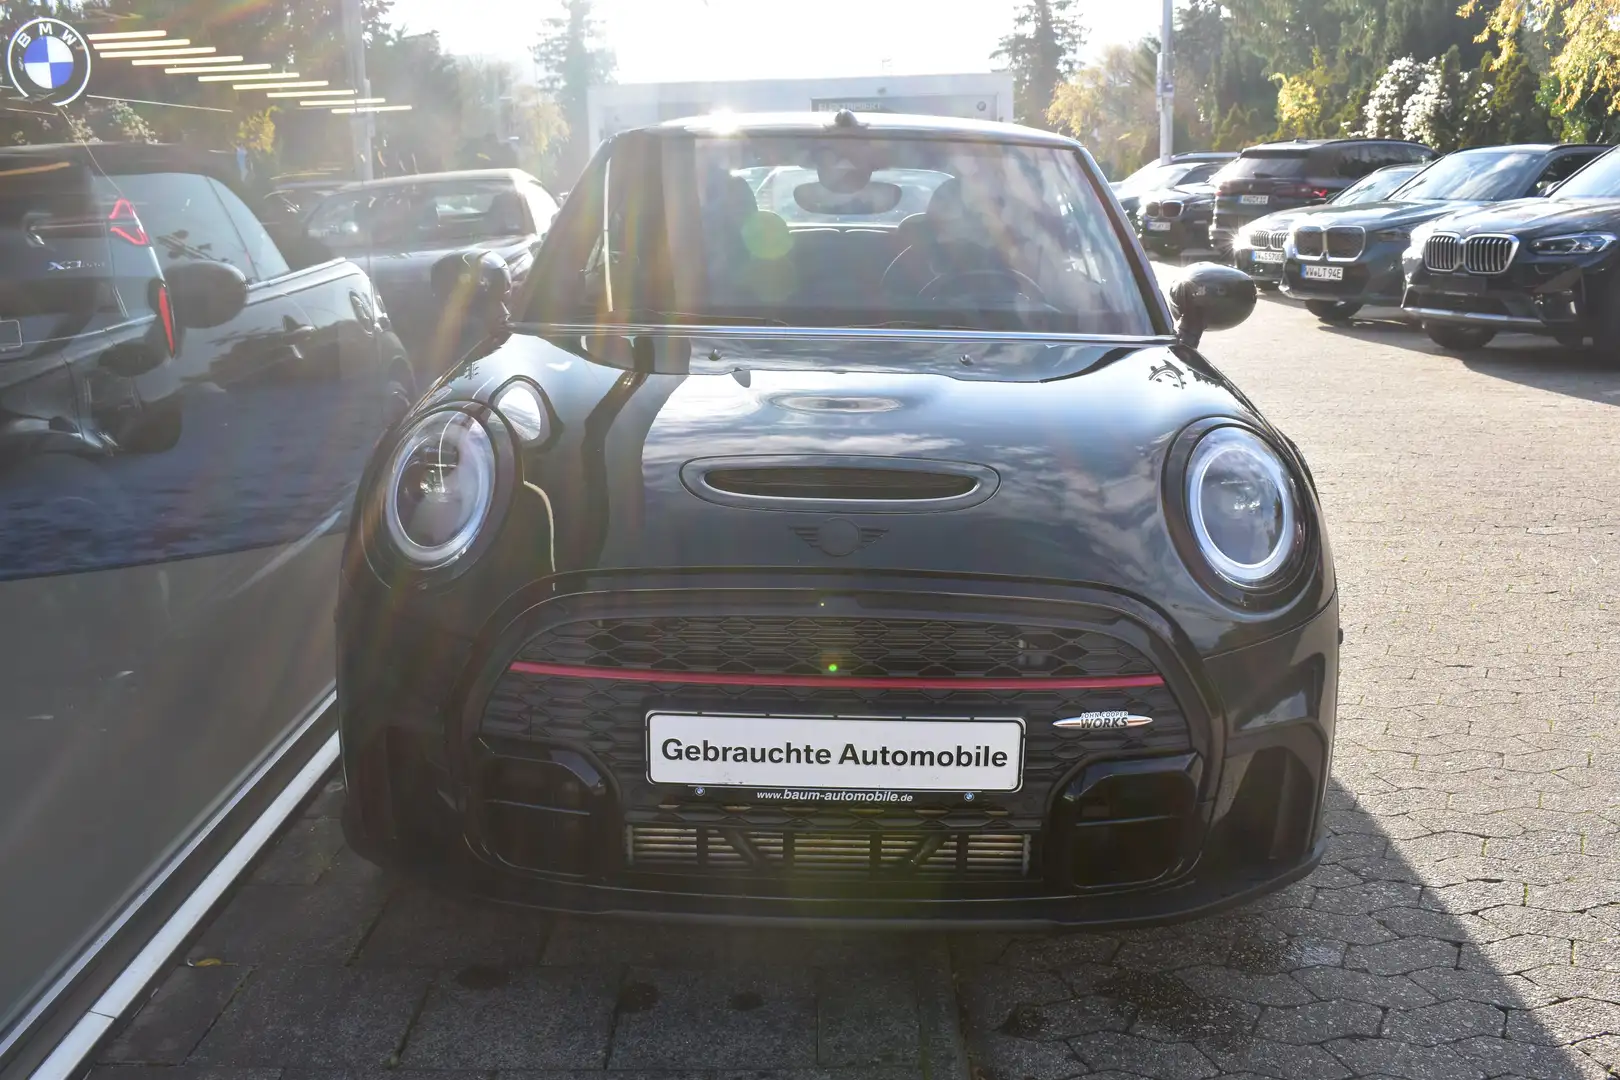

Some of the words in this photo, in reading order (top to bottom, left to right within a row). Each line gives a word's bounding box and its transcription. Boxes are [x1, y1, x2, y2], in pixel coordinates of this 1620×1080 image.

[16, 22, 78, 49] BMW
[1080, 711, 1100, 719] JOHN
[1080, 717, 1128, 729] WORKS
[661, 738, 832, 765] Gebrauchte
[838, 743, 1009, 768] Automobile
[756, 789, 913, 802] www.baum-automobile.de
